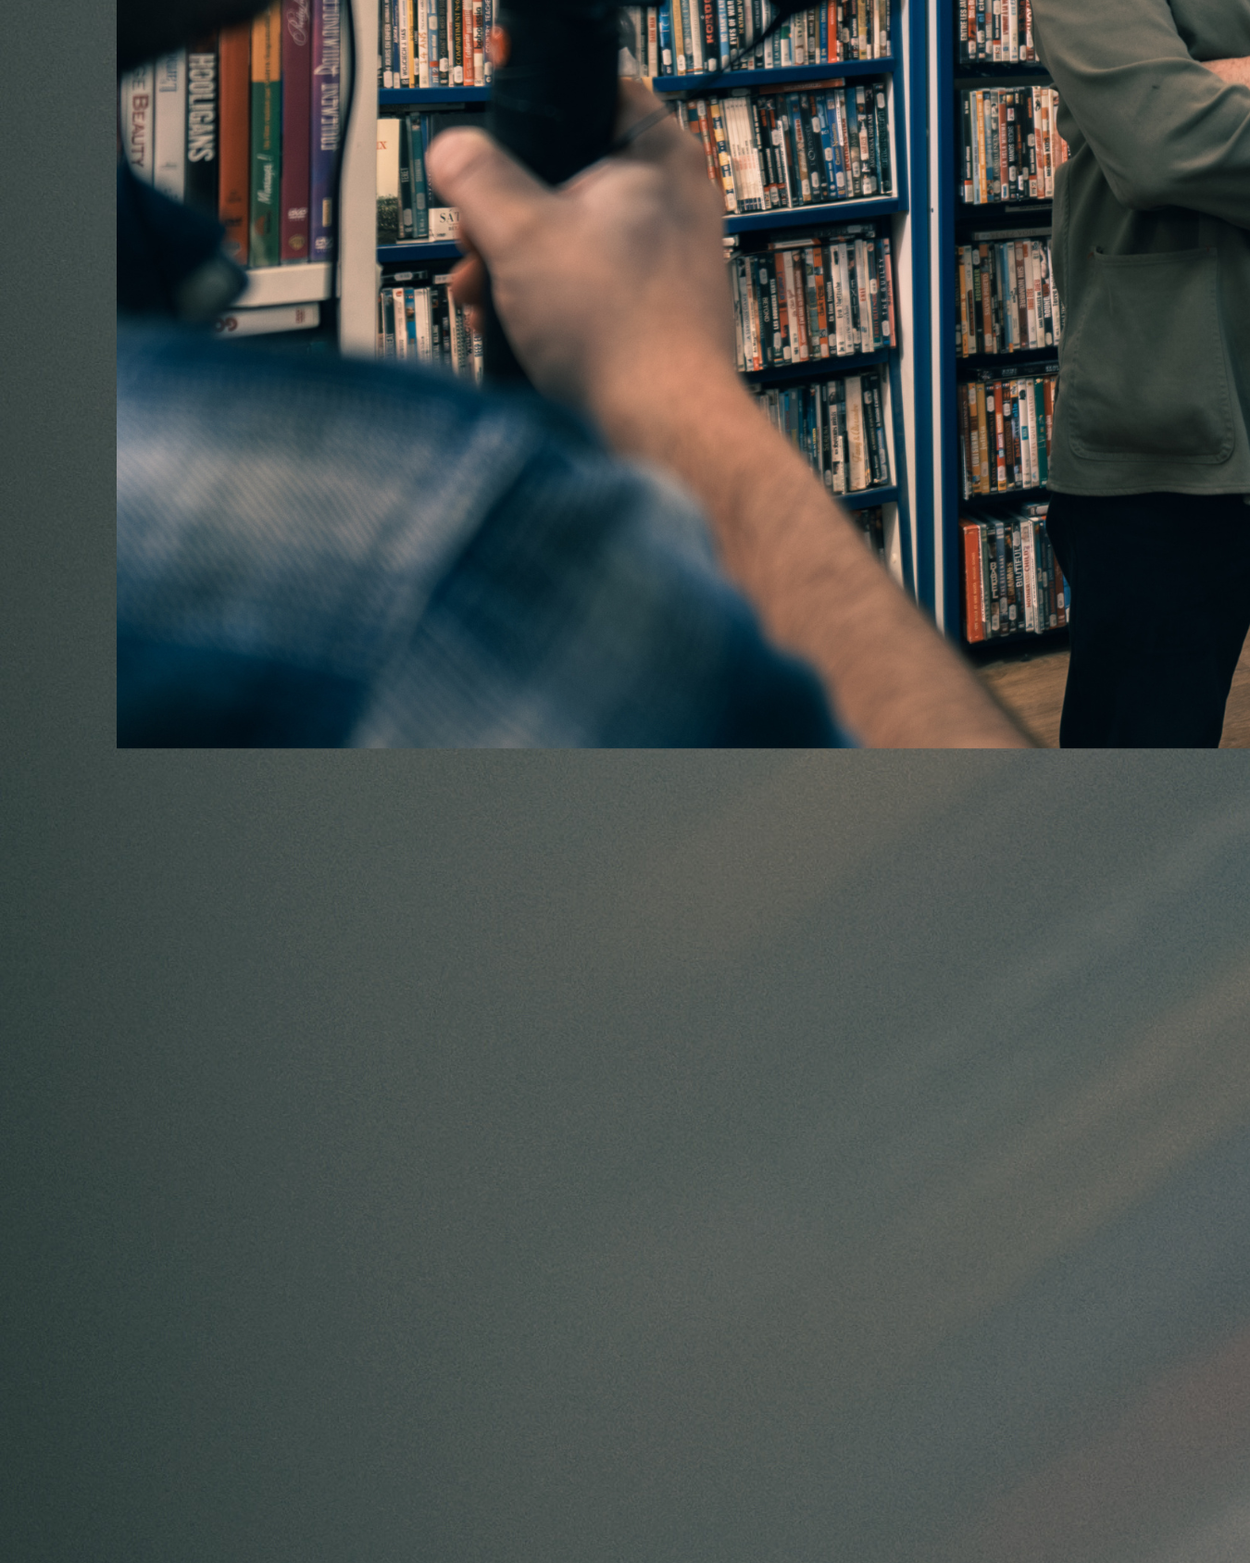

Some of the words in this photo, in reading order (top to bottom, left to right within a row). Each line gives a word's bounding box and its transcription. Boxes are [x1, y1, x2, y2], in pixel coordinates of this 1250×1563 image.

[719, 14, 727, 32] MAN'S
[728, 18, 735, 27] OF
[737, 7, 745, 34] KATALIN
[960, 19, 968, 41] ENTRE
[419, 32, 427, 49] ANS
[721, 33, 728, 42] NO
[420, 51, 427, 64] 14
[187, 54, 215, 162] HOOLIGANS
[974, 269, 982, 301] REDEEMER
[1018, 278, 1026, 309] NOMBRE
[1014, 547, 1023, 587] BIUTIFUL
